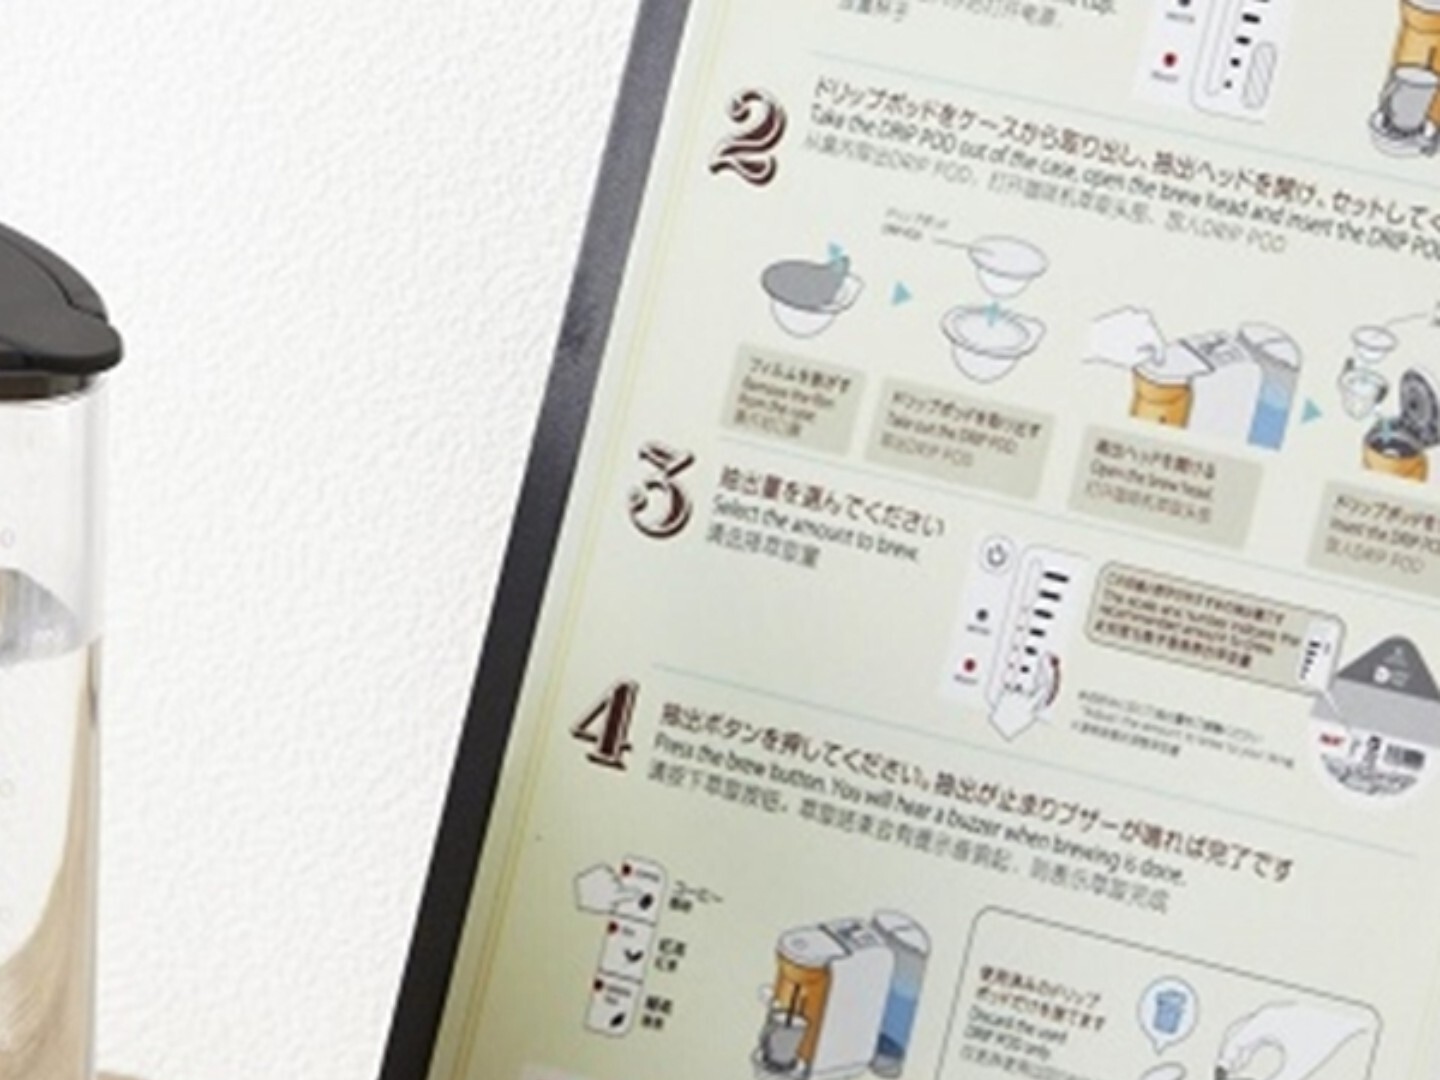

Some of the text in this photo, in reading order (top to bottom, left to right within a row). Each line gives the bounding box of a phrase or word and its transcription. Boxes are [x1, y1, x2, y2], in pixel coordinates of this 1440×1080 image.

[709, 89, 787, 186] 2
[810, 102, 844, 129] Take
[847, 113, 876, 136] the
[877, 118, 918, 142] DRIP
[917, 126, 957, 154] POD
[958, 139, 988, 161] out
[987, 143, 1010, 164] of
[1008, 149, 1038, 170] the
[1081, 167, 1125, 190] open
[1127, 175, 1157, 199] the
[1159, 182, 1202, 207] brew
[1204, 191, 1249, 218] head
[1250, 205, 1285, 226] and
[1287, 212, 1333, 236] insert
[1336, 219, 1365, 244] the
[1366, 225, 1409, 251] DRIP
[629, 442, 695, 540] 3
[712, 493, 760, 523] Select
[761, 507, 789, 529] the
[790, 518, 854, 545] amount
[855, 530, 874, 552] to
[570, 679, 641, 771] 4
[653, 731, 694, 759] Press
[695, 743, 724, 767] the
[725, 750, 766, 776] brew
[830, 776, 862, 803] You
[863, 789, 894, 809] will
[893, 793, 932, 820] hear
[946, 807, 1002, 836] buzzer
[1003, 825, 1050, 848] when
[1051, 834, 1121, 873] brewing
[1122, 854, 1137, 874] is
